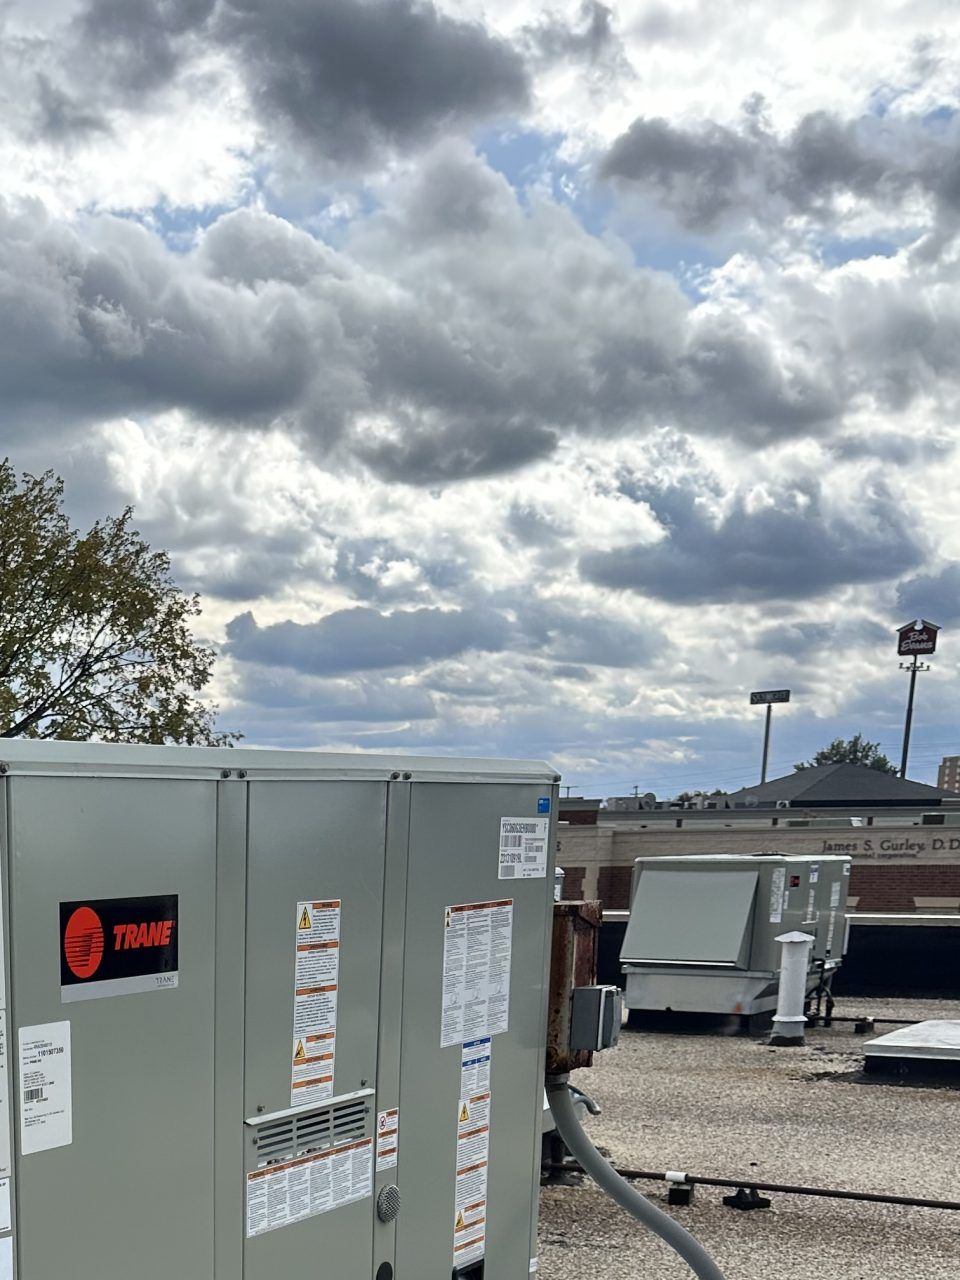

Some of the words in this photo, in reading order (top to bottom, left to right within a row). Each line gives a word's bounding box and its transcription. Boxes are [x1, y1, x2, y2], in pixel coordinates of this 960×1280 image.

[907, 631, 928, 641] Bob
[822, 840, 858, 852] James
[863, 840, 874, 851] S.
[113, 920, 173, 951] TRANE
